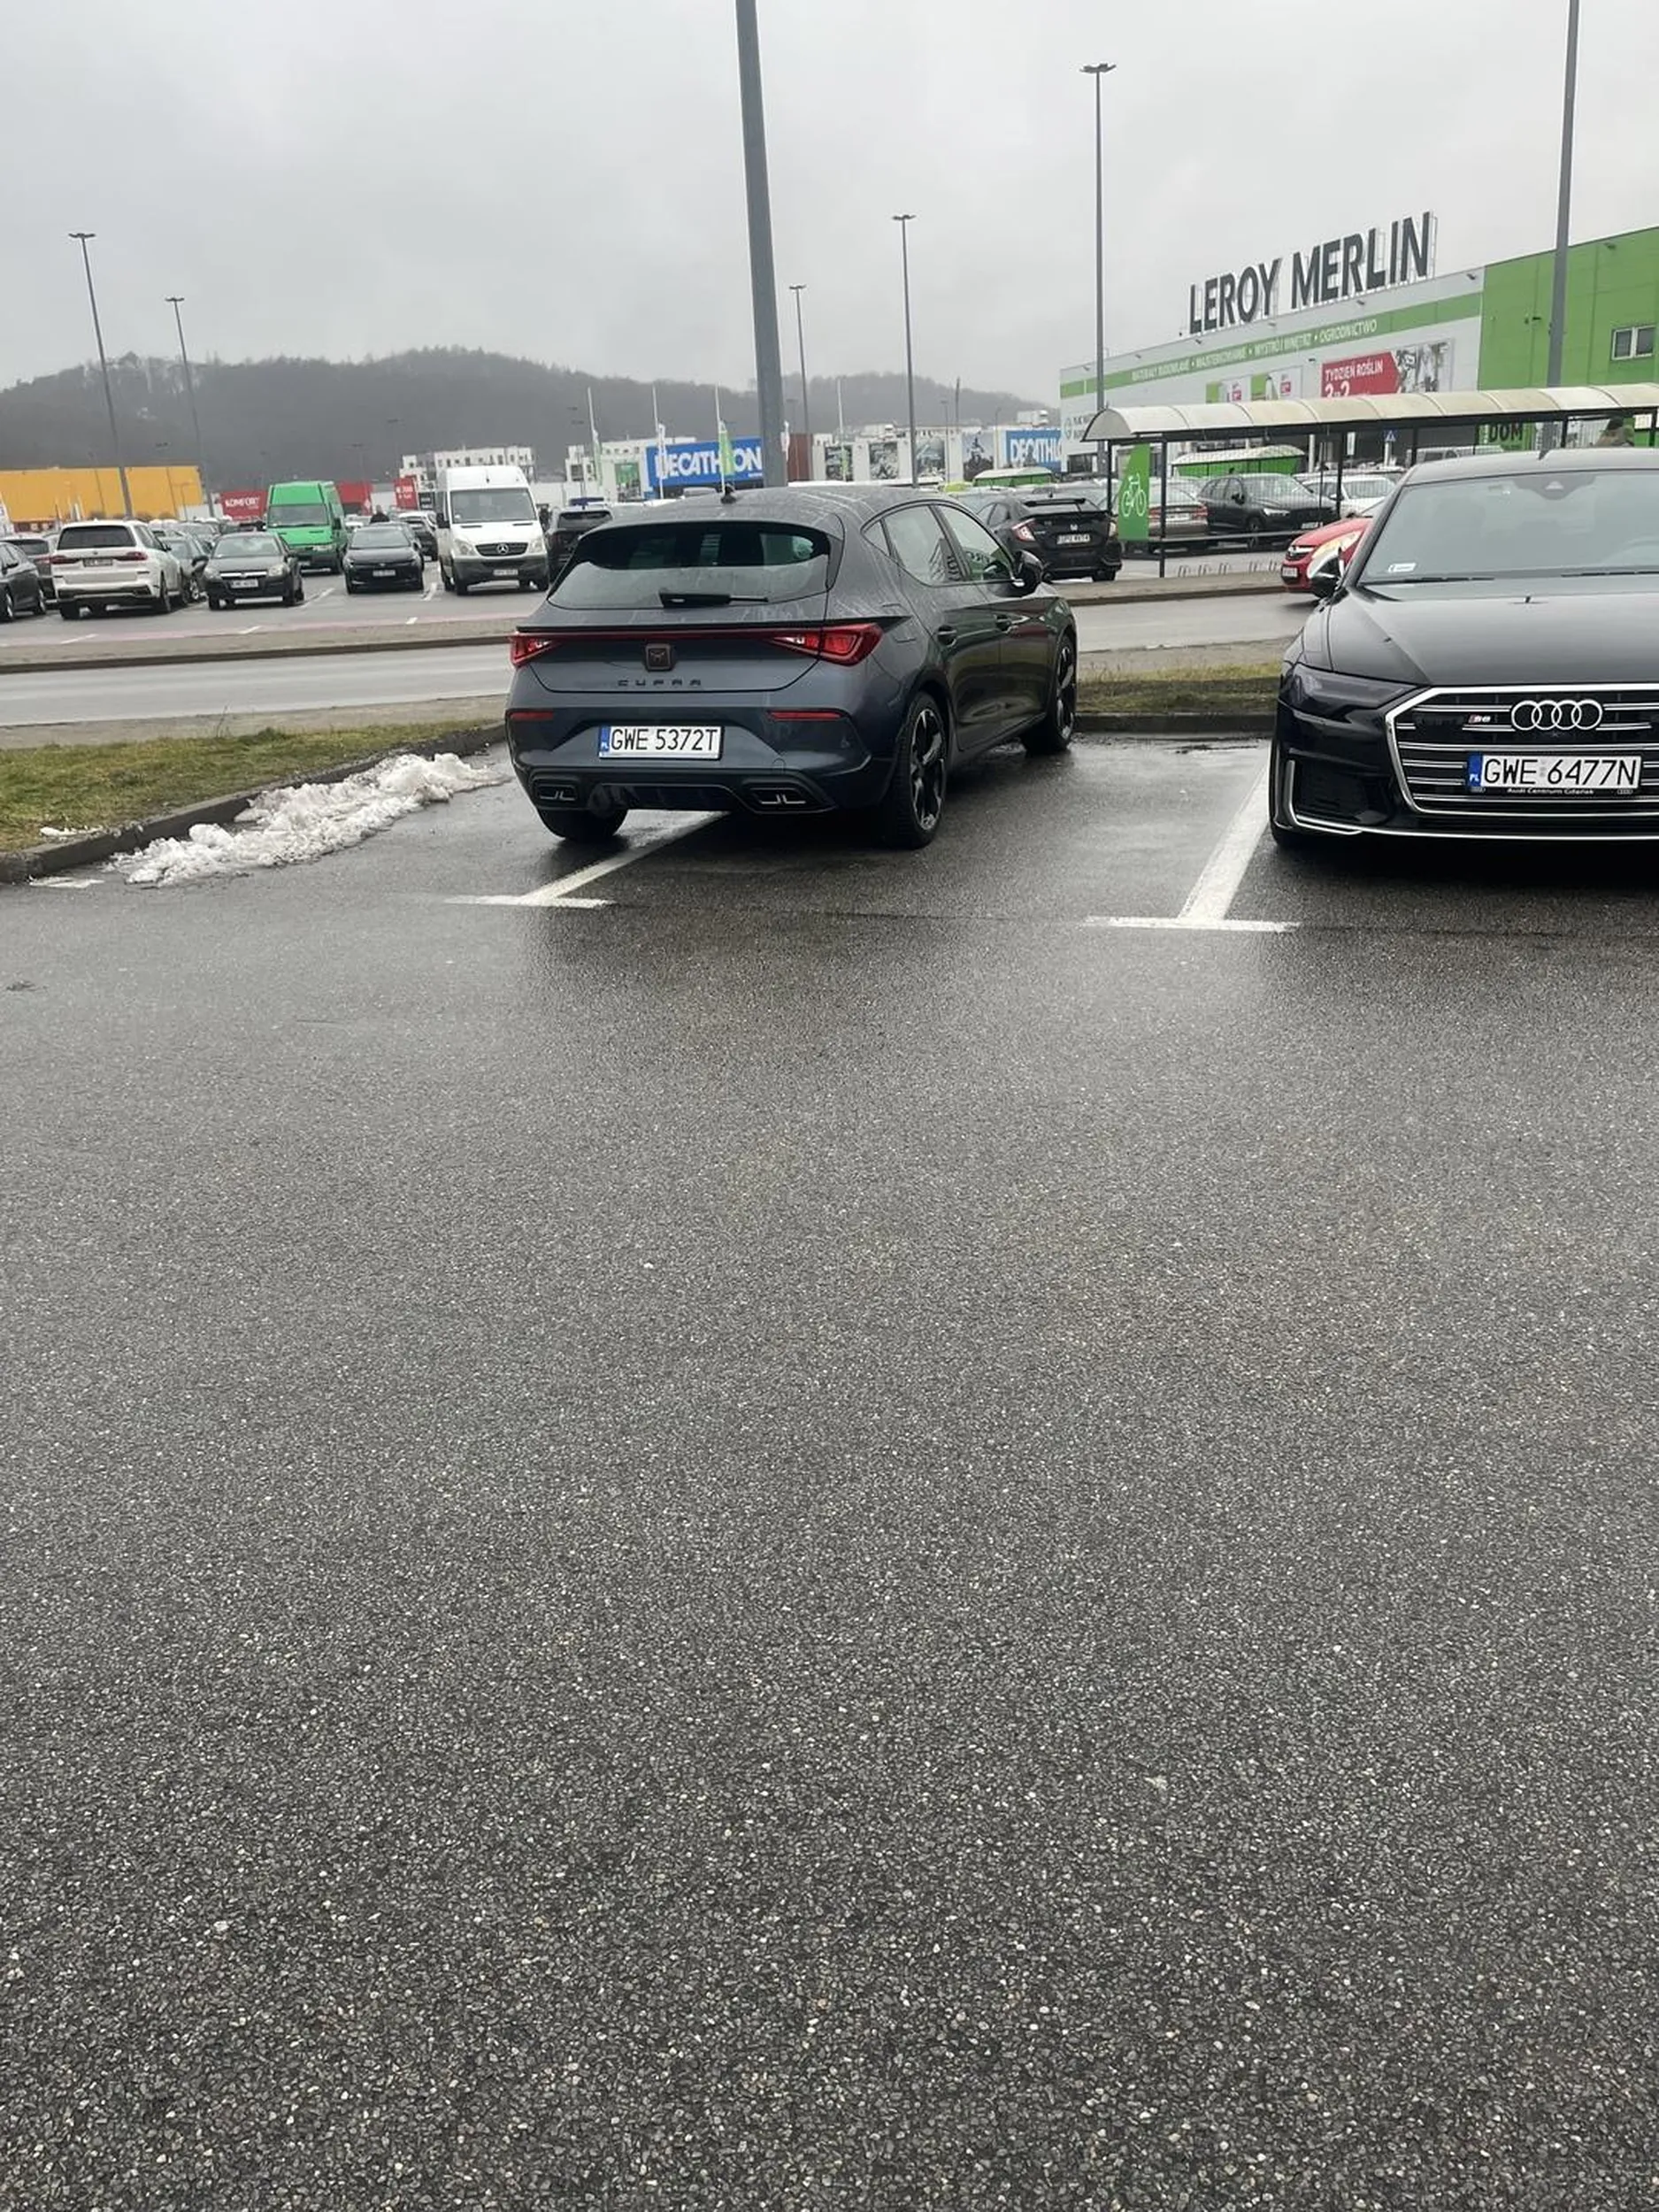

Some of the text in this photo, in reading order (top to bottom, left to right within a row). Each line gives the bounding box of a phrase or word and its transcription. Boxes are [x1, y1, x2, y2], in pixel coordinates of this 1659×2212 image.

[1190, 211, 1431, 334] LEROY MERLIN
[655, 446, 763, 479] DECATHON
[611, 728, 718, 750] GWE 5372T
[1484, 758, 1637, 786] GWE 6477N
